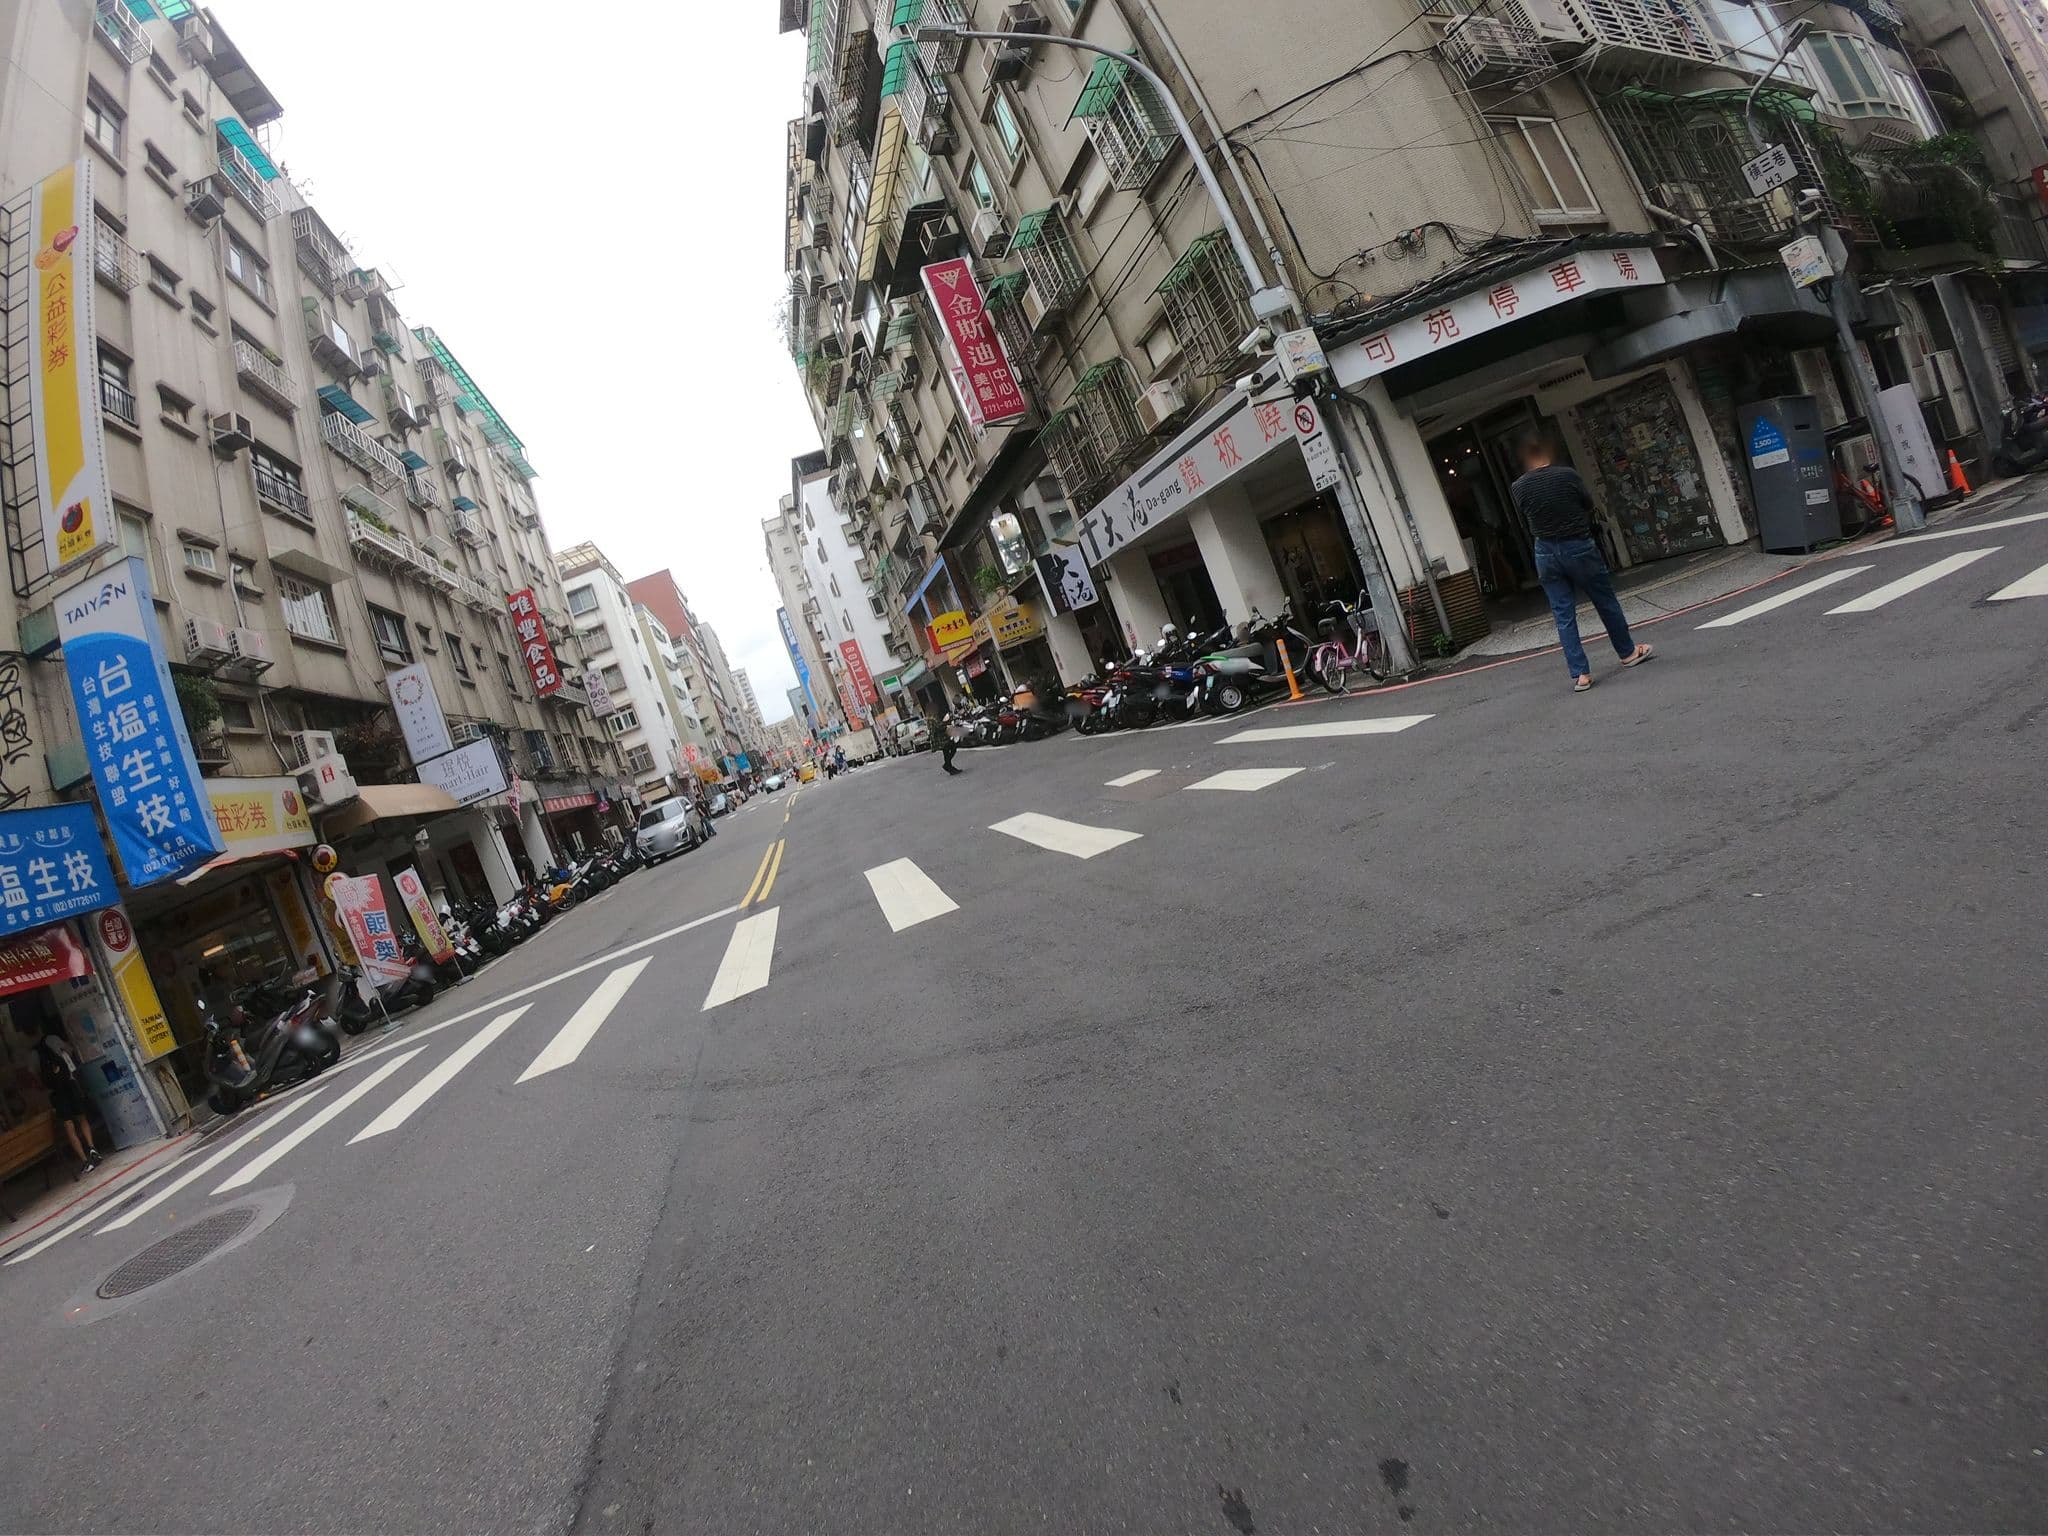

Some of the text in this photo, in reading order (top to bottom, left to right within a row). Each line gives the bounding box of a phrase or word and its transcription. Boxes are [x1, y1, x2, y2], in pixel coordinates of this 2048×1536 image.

[1747, 150, 1786, 181] 橫三巷
[1765, 172, 1783, 188] H3
[47, 273, 68, 373] 公益彩券
[1360, 252, 1639, 363] 可苑停車場
[948, 293, 997, 368] 金斯迪
[972, 372, 996, 402] 美髮
[992, 367, 1015, 396] 中心
[1178, 400, 1288, 495] 鐵板燒
[1146, 479, 1182, 512] Da-gang
[509, 595, 555, 689] 唯豐食品
[98, 654, 176, 838] 台塩生技
[141, 1013, 163, 1025] TAIWAN
[149, 1031, 170, 1045] LOTTERY
